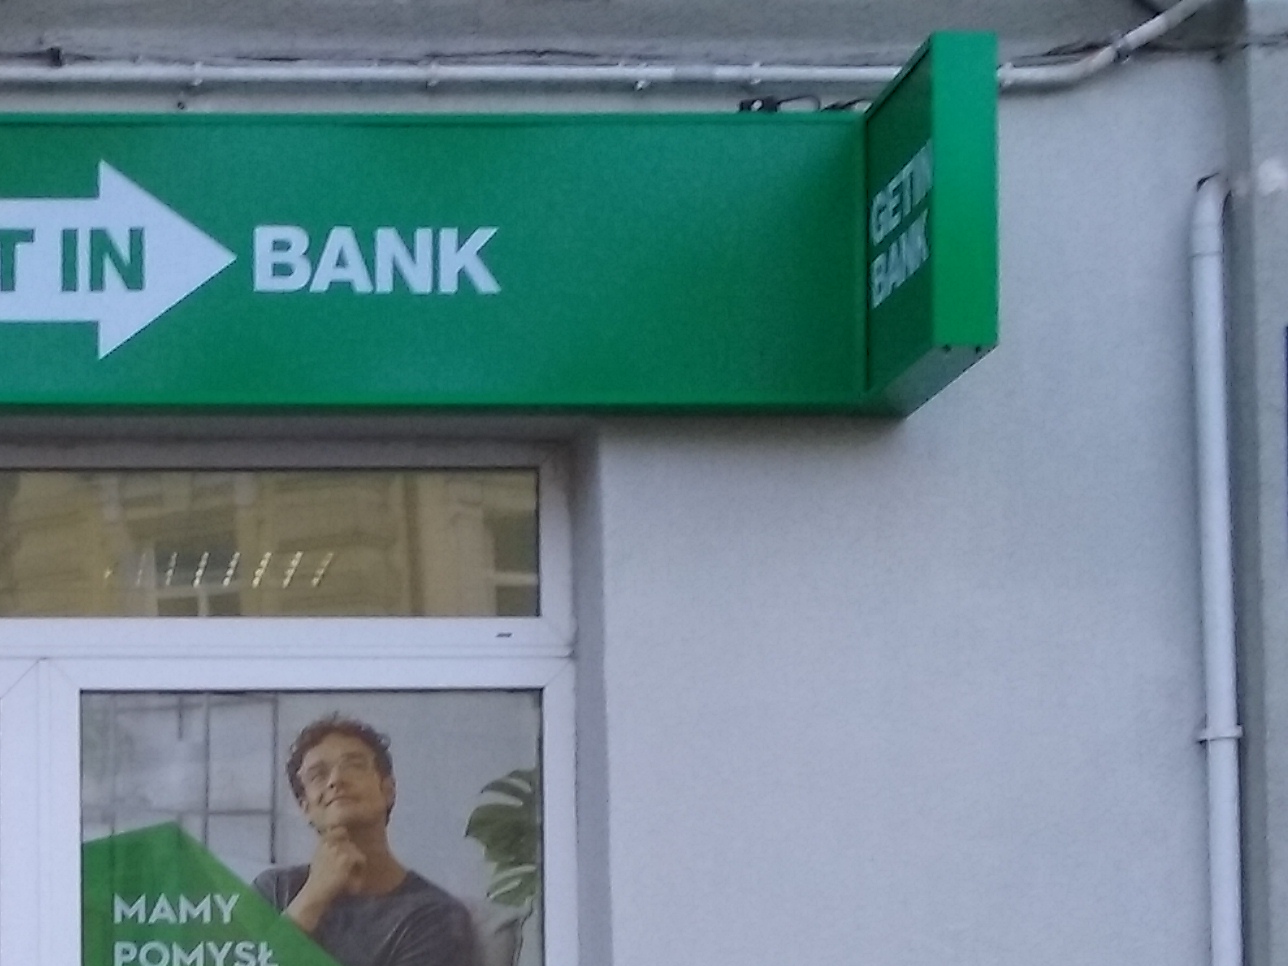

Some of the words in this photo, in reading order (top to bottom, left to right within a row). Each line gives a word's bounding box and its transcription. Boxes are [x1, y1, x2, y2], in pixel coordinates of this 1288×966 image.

[60, 226, 145, 292] IN
[252, 225, 501, 293] BANK
[113, 893, 239, 924] MAMY
